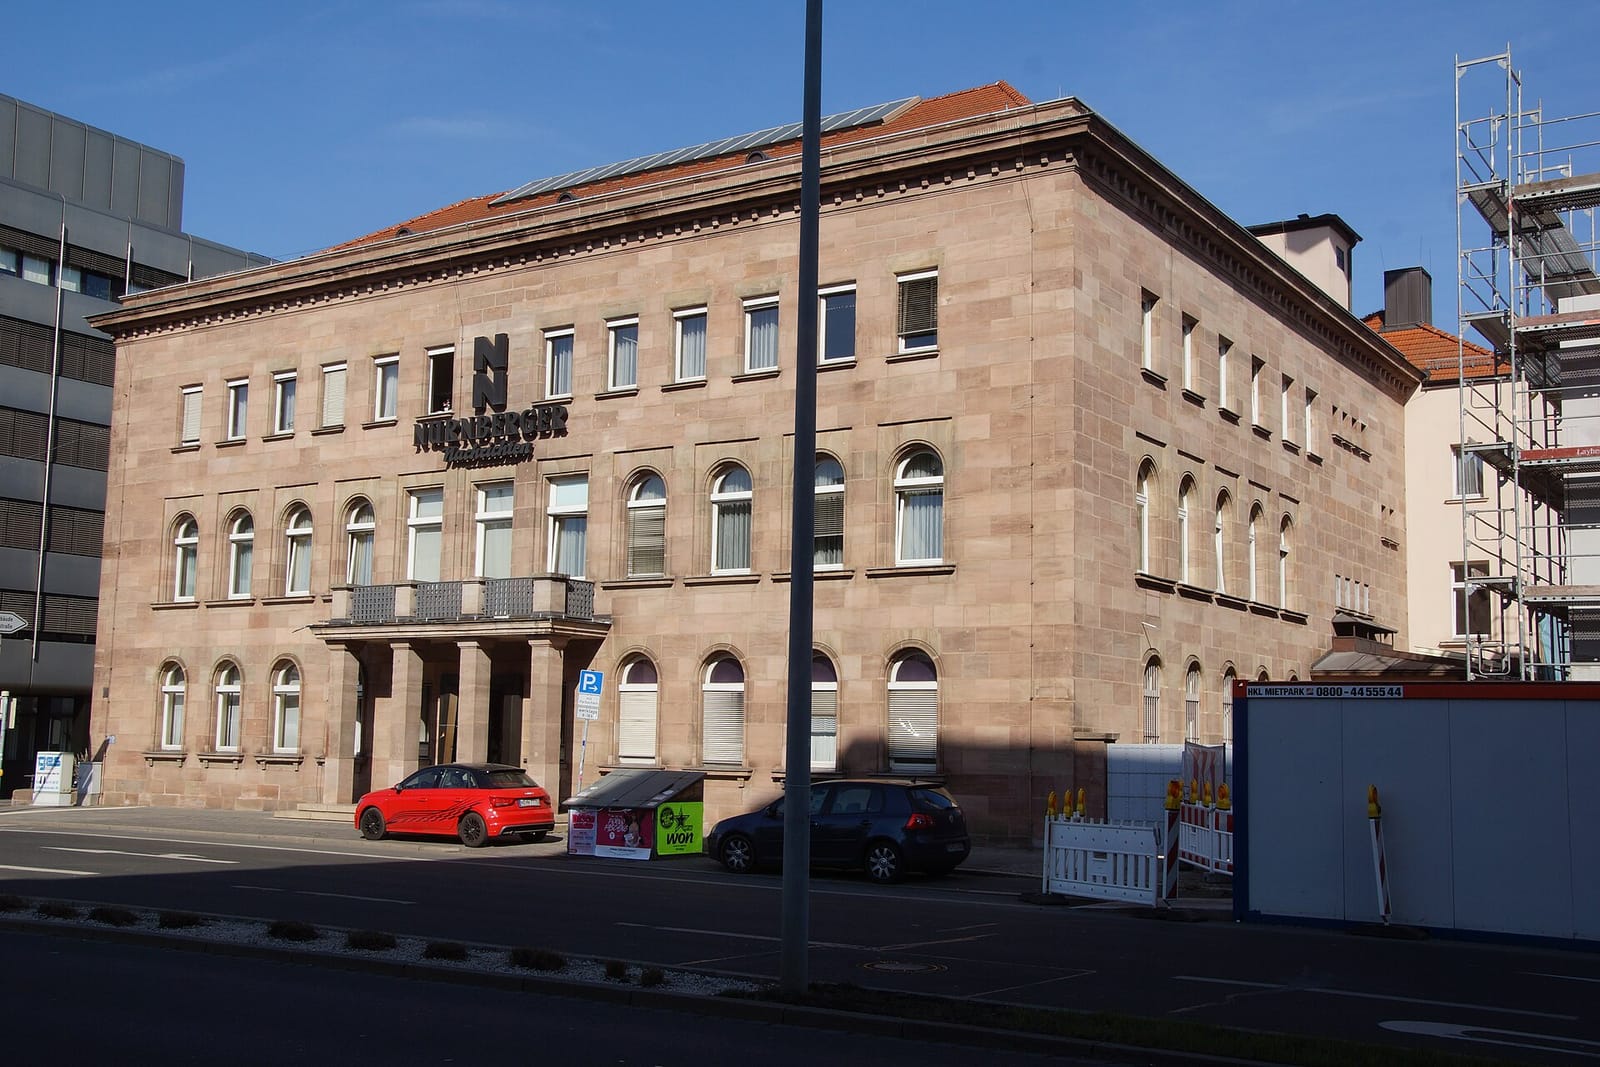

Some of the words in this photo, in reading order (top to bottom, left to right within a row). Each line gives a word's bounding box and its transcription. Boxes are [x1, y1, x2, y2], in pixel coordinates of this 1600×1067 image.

[583, 673, 596, 691] P
[1248, 687, 1263, 696] HKL
[1265, 687, 1305, 696] MIETPARK
[1316, 686, 1343, 697] 0800
